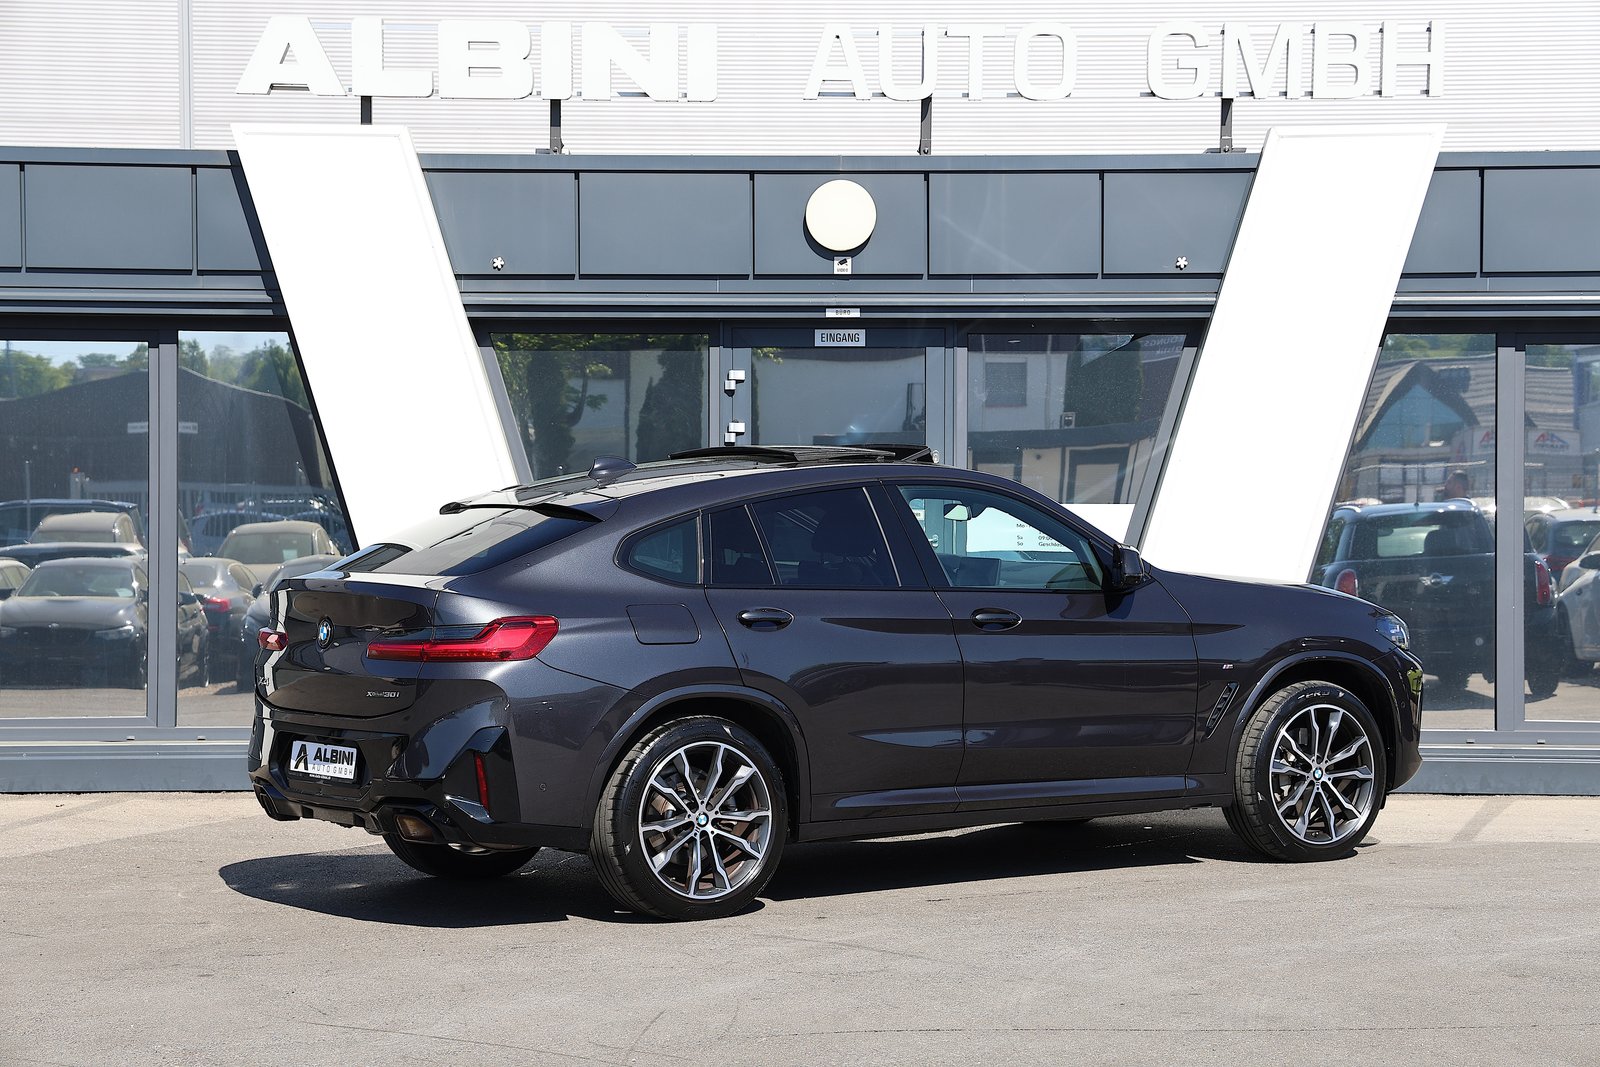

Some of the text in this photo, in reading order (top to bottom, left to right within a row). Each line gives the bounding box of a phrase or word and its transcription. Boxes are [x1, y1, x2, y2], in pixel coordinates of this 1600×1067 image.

[235, 16, 1446, 102] ALBINI AUTO GMBH
[821, 333, 860, 343] EINGANG
[313, 747, 354, 766] ALBINI
[311, 763, 353, 776] AUTO GMBH
